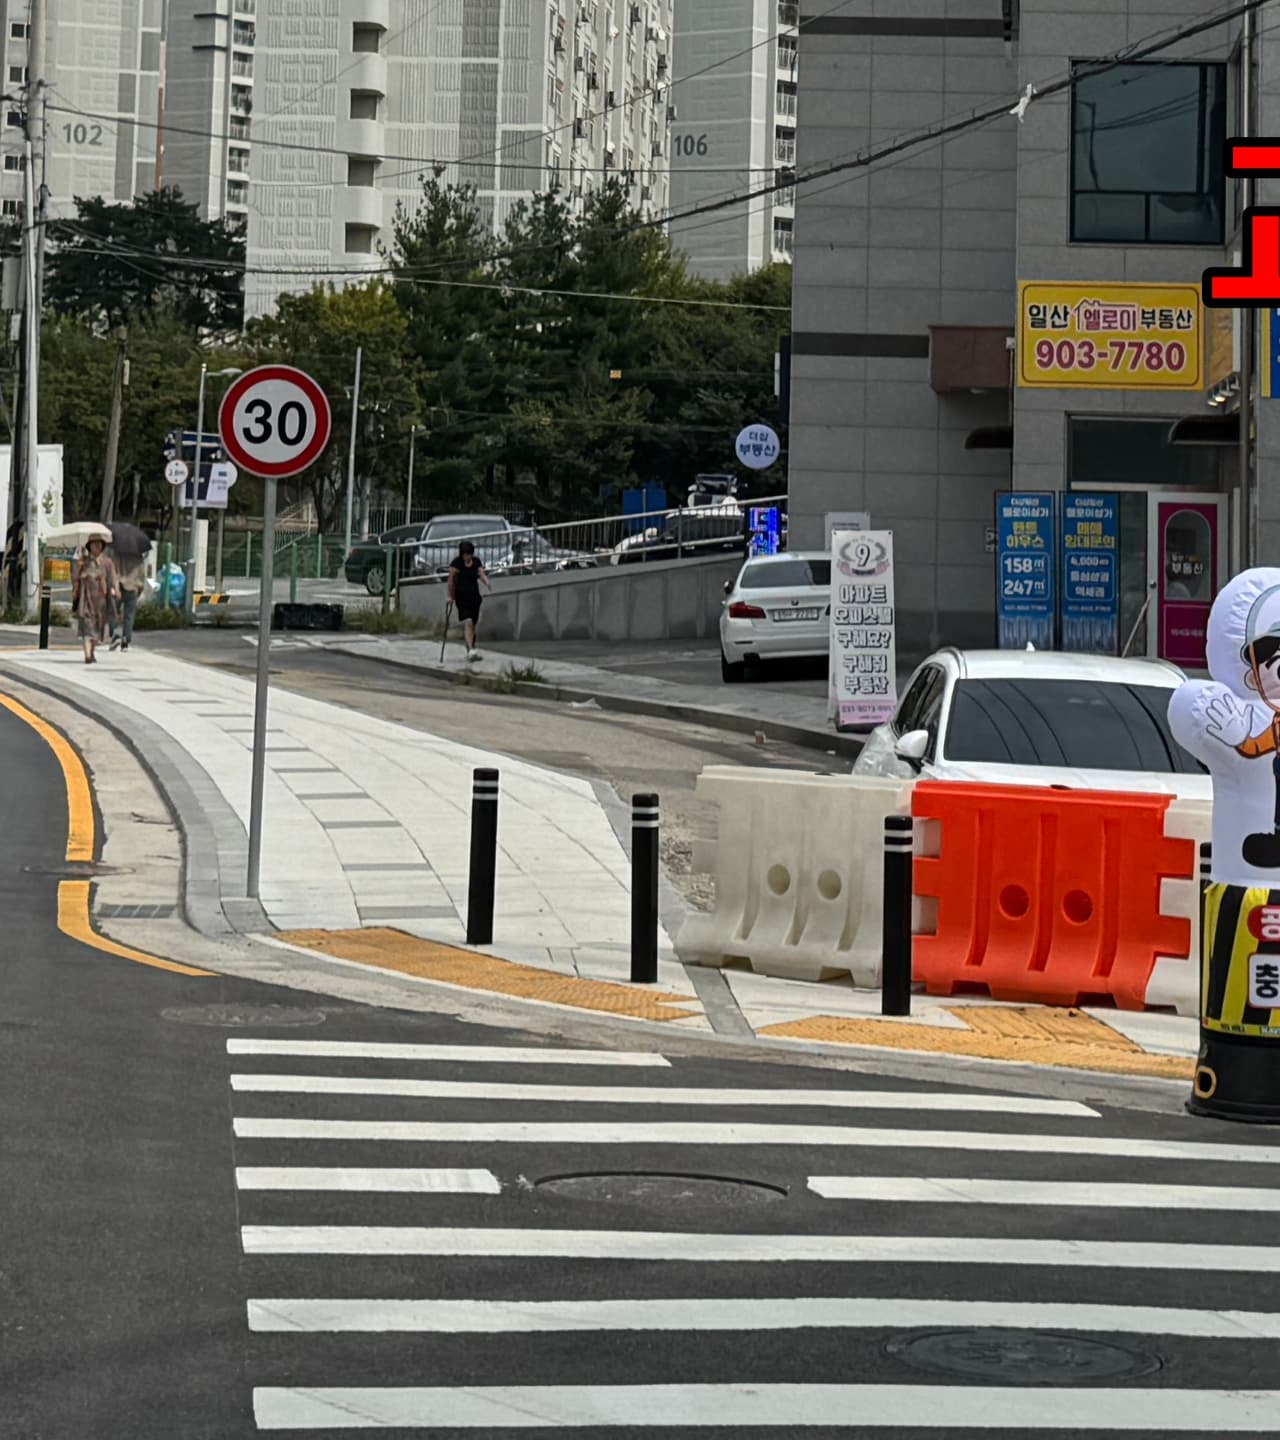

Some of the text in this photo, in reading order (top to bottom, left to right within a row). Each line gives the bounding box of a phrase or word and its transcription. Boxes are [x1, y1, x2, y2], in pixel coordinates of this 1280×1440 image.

[62, 122, 103, 146] 102
[673, 134, 707, 157] 106
[1028, 304, 1070, 329] 일산
[1140, 309, 1193, 330] 부동산
[1035, 340, 1186, 371] 903-7780
[242, 399, 307, 446] 30
[739, 443, 776, 457] 부동산
[854, 543, 872, 568] 9
[839, 584, 888, 604] 아파트
[834, 606, 893, 626] 오피스텔
[837, 629, 892, 649] 구해요?
[844, 675, 890, 695] 부동산
